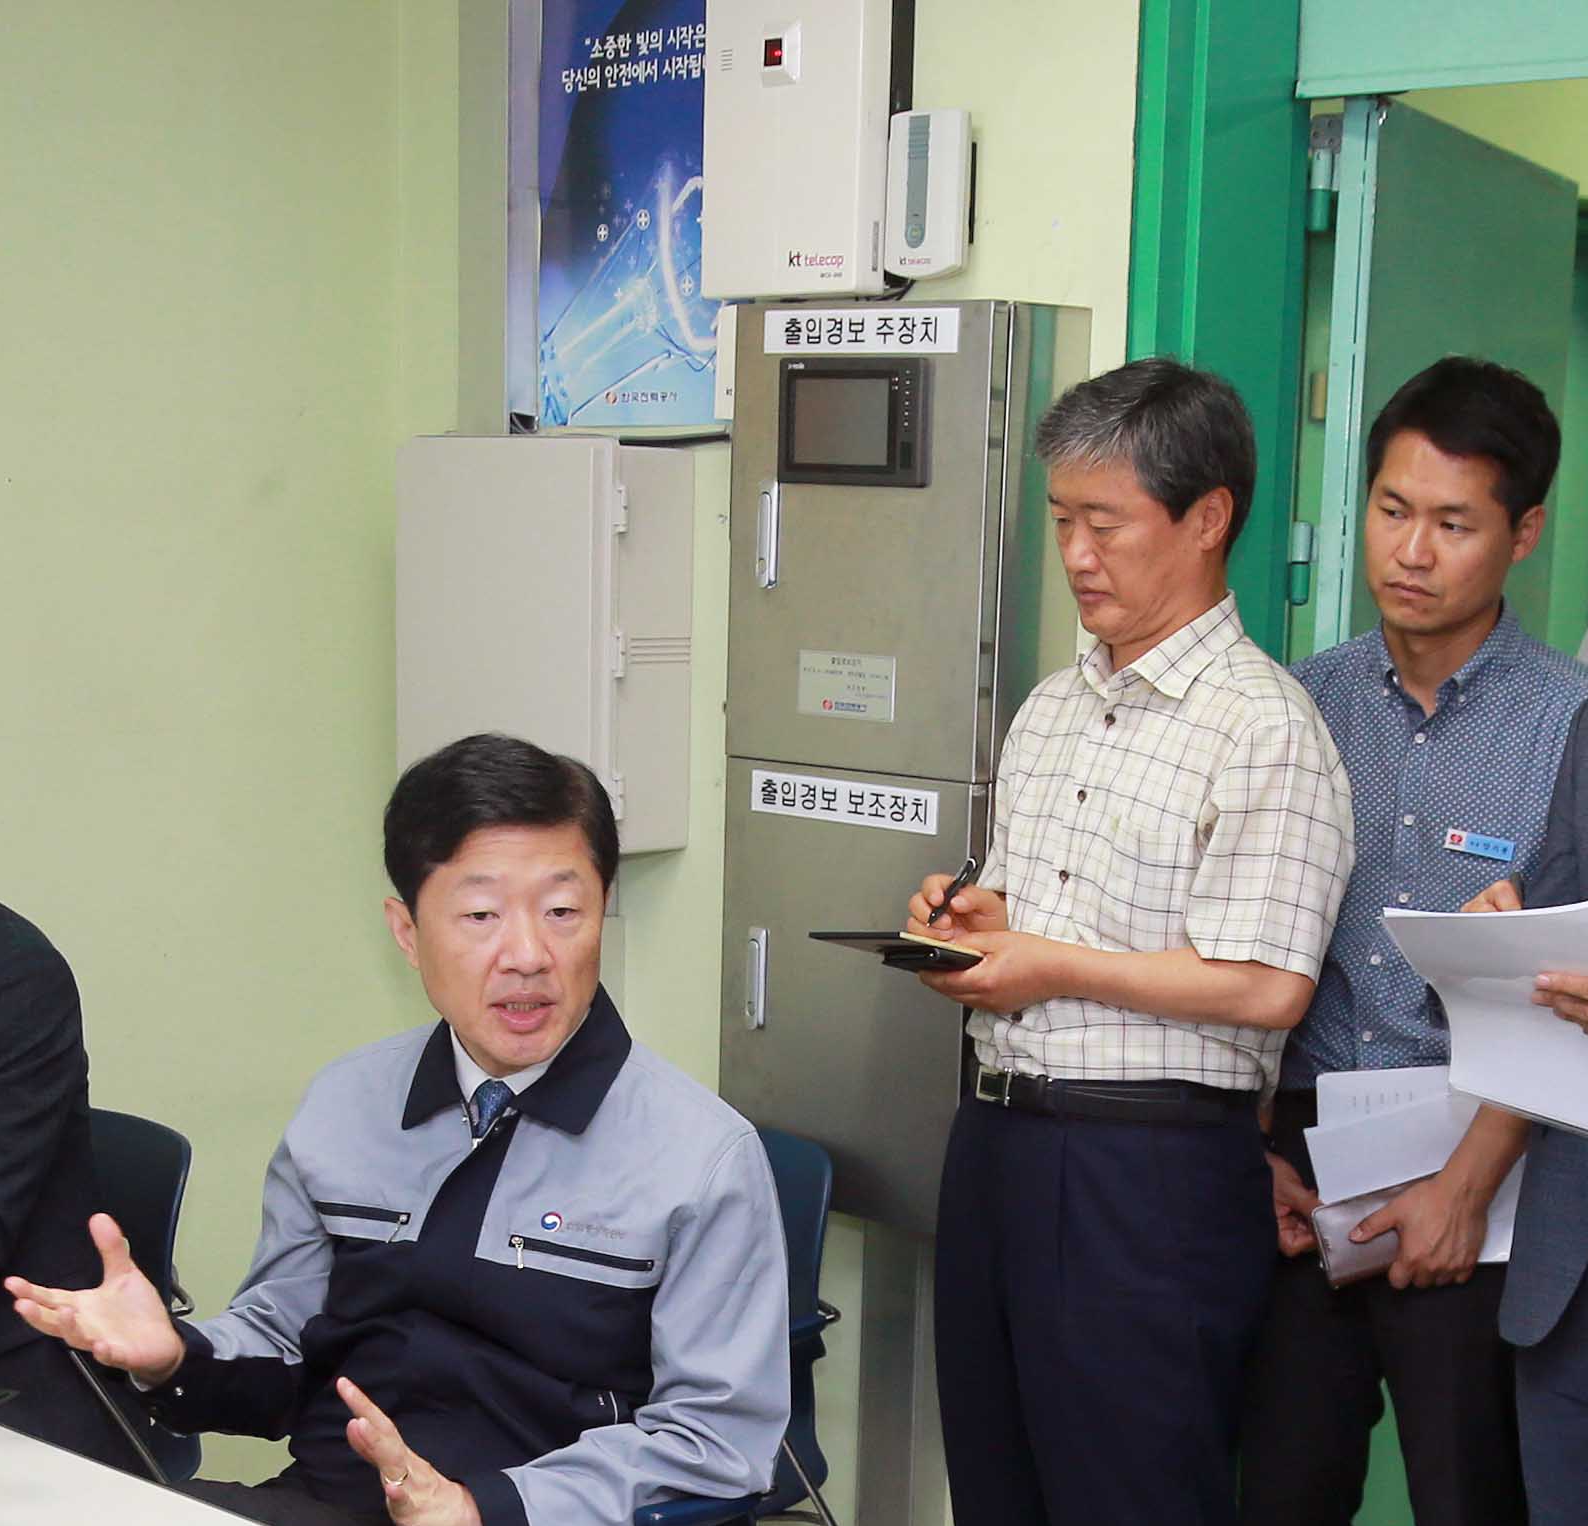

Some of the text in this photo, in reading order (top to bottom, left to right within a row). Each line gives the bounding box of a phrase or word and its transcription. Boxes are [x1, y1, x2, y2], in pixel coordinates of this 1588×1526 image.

[636, 29, 663, 56] 빛의
[667, 23, 706, 51] 시작은
[561, 53, 706, 93] 당신의 안전에서 시작됩
[788, 251, 845, 269] kt telecop
[784, 316, 939, 345] 출입경보 주장치
[761, 778, 929, 825] 출입경보 보조장치
